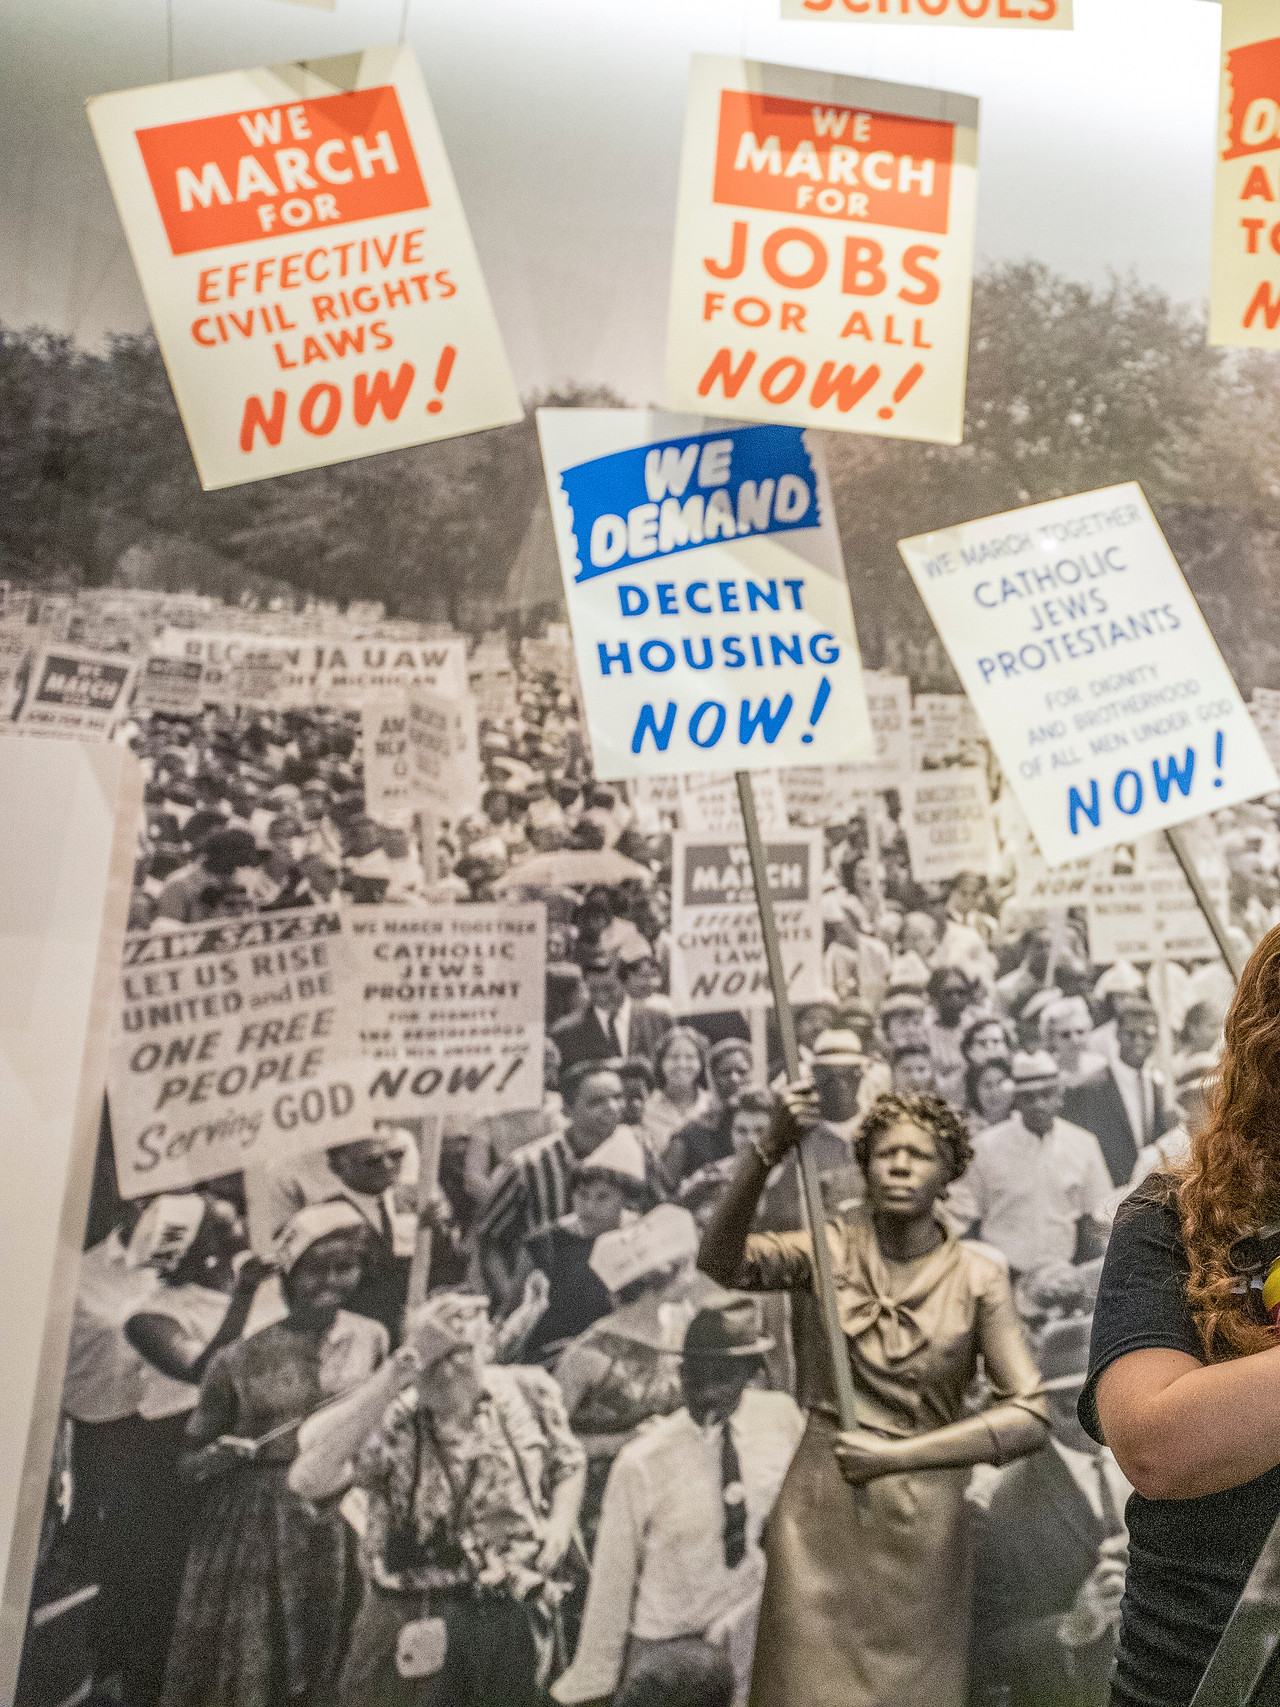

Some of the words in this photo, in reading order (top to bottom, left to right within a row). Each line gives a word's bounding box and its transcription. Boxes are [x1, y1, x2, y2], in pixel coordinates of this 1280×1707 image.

[239, 105, 312, 148] WE
[812, 106, 871, 143] WE
[174, 130, 398, 212] MARCH
[734, 131, 935, 197] MARCH
[257, 197, 340, 232] FOR
[797, 186, 869, 218] FOR
[197, 228, 427, 303] EFFECTIVE
[703, 221, 941, 306] JOBS
[191, 311, 298, 347] CIVIL
[313, 269, 457, 322] RIGHTS
[703, 292, 807, 333] FOR
[839, 311, 932, 350] ALL
[274, 320, 394, 371] LAWS
[239, 344, 457, 453] NOW!
[697, 347, 925, 420] NOW!
[644, 438, 734, 503] WE
[589, 473, 811, 568] DEMAND
[923, 553, 957, 578] WE
[960, 532, 1034, 566] MARCH
[1039, 503, 1143, 545] TOGETHER
[617, 579, 805, 617] DECENT
[973, 546, 1128, 609] CATHOLIC
[1032, 588, 1108, 633] JEWS
[363, 647, 449, 669] UAW
[598, 633, 841, 676] HOUSING
[977, 603, 1182, 685] PROTESTANTS
[630, 676, 831, 754] NOW!
[1027, 720, 1068, 746] AND
[1073, 678, 1200, 731] BROTHERHOOD
[1044, 685, 1080, 711] FOR
[1089, 662, 1159, 698] DIGNITY
[1019, 756, 1044, 780] OF
[1050, 748, 1081, 772] ALL
[1090, 733, 1130, 755] MEN
[1134, 714, 1191, 743] UNDER
[1196, 698, 1234, 722] GOD
[1067, 728, 1224, 836] NOW!
[124, 971, 180, 1003] LET
[195, 959, 239, 988] US
[251, 943, 328, 977] RISE
[373, 942, 514, 961] CATHOLIC
[404, 964, 483, 978] JEWS
[714, 950, 763, 964] LAW
[122, 990, 243, 1031] UNITED
[296, 972, 332, 997] BE
[364, 980, 520, 1000] PROTESTANT
[129, 1030, 221, 1073] ONE
[236, 1007, 336, 1053] FREE
[154, 1049, 325, 1111] PEOPLE
[369, 1056, 524, 1098] NOW!
[132, 1108, 263, 1173] Serving
[273, 1082, 355, 1131] GOD
